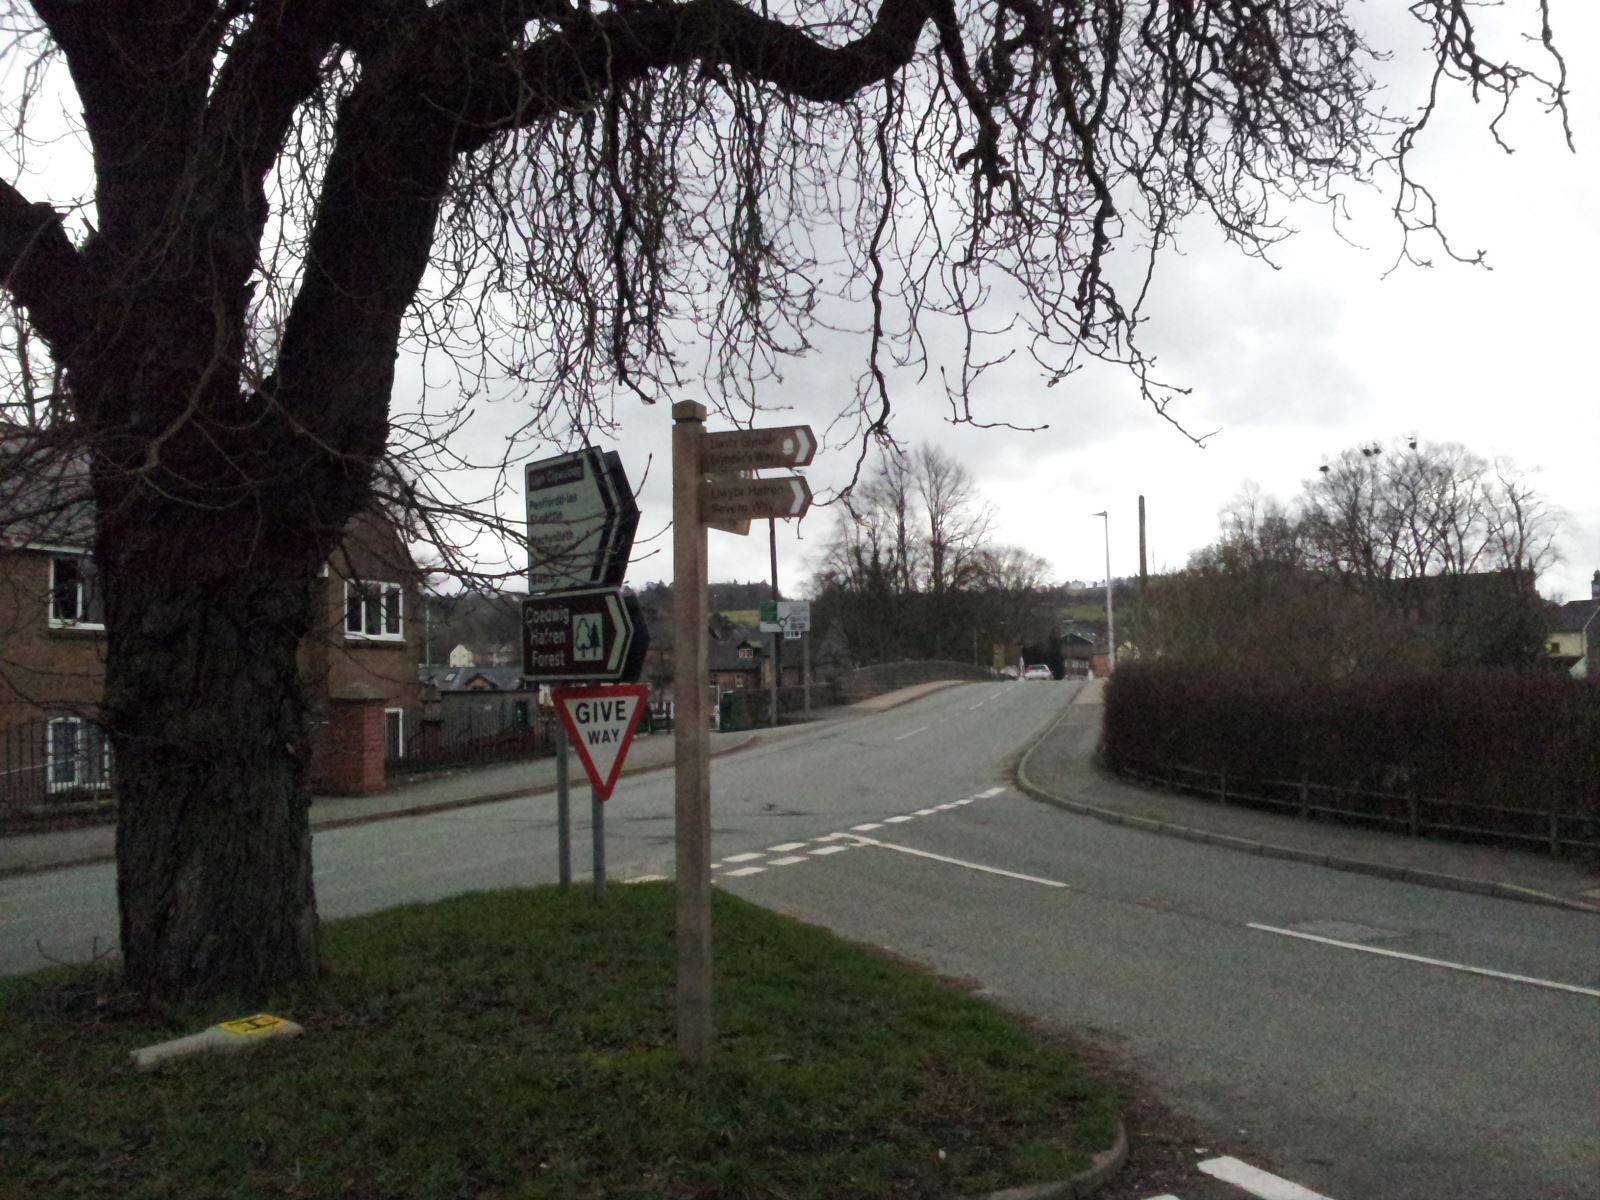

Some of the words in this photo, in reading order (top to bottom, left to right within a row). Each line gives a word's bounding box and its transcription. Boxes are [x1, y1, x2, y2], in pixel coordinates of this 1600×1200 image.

[525, 606, 570, 625] Coedwig
[530, 629, 566, 646] Hafren
[532, 650, 566, 668] Forest
[575, 700, 627, 725] GIVE
[587, 729, 620, 745] WAY
